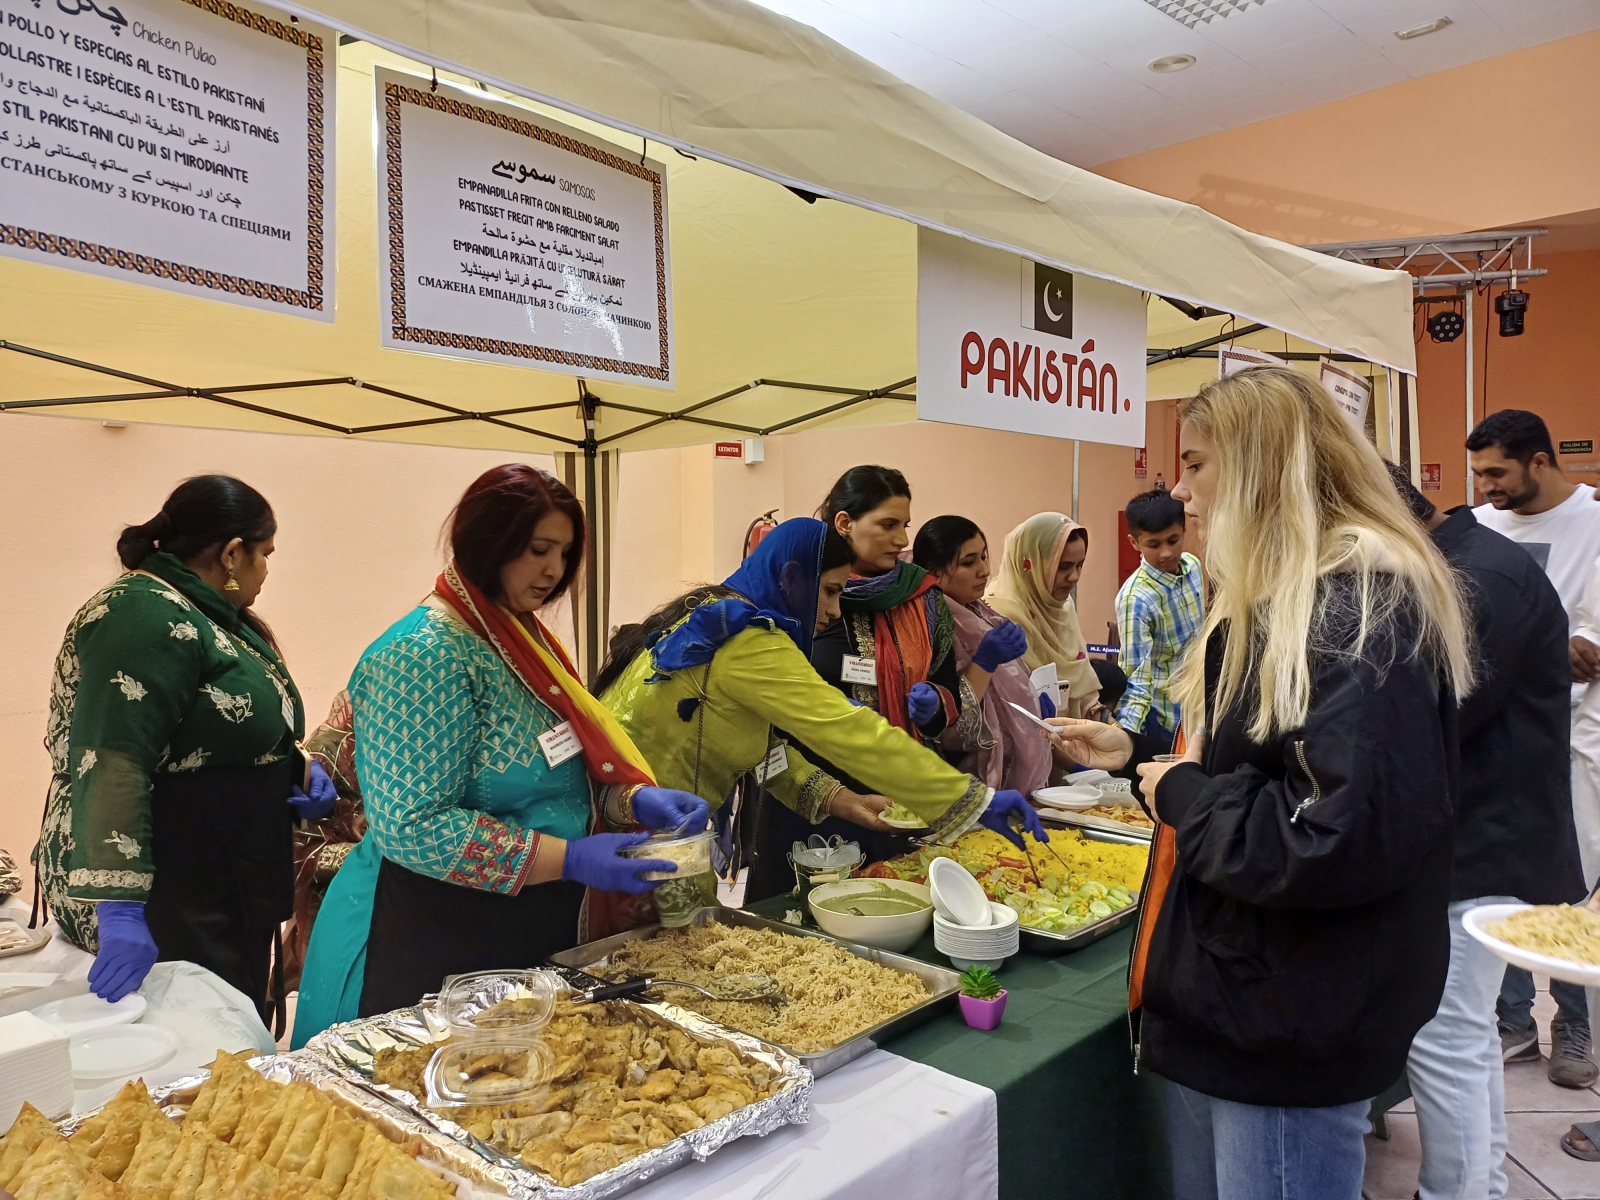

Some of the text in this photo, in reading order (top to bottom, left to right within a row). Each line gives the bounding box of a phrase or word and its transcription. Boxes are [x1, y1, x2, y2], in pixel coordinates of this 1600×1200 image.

[133, 21, 217, 65] Chicken Pulao
[8, 13, 54, 39] POLLO
[59, 29, 70, 44] Y
[74, 34, 133, 67] ESPECIAS
[137, 58, 153, 75] AL
[157, 64, 200, 90] ESTILO
[203, 81, 265, 113] PAKISTANÍ
[18, 80, 58, 98] الدجاج
[62, 94, 79, 107] مع
[77, 66, 81, 79] I
[85, 68, 142, 99] ESPÈCIES
[145, 89, 154, 103] A
[208, 110, 280, 143] PAKISTANÉS
[83, 95, 142, 124] الباكستانية
[145, 115, 185, 138] الطريقة
[13, 134, 41, 149] طرز
[40, 109, 114, 143] PAKISTANI
[117, 133, 134, 149] CU
[138, 138, 157, 157] PUI
[160, 147, 171, 161] SI
[174, 150, 249, 183] MIRODIANTE
[491, 160, 556, 185] سموسے
[196, 188, 213, 199] اور
[216, 192, 242, 208] چکن
[458, 177, 620, 232] EMPANADILLA FRITA CON RELLENO SALADO
[131, 189, 195, 217] КУРКОЮ
[198, 207, 218, 223] ТА
[221, 214, 291, 241] СПЕЦІЯМИ
[459, 198, 620, 250] PASTISSET FREGIT AMB FARCIMENT SALAT
[482, 223, 509, 240] مالحة
[539, 241, 551, 254] مع
[453, 239, 509, 261] EMPANDILLA
[510, 251, 546, 269] PRĂJITĂ
[546, 260, 557, 272] CU
[602, 275, 626, 288] SĂRAT
[417, 275, 476, 296] СМАЖЕНА
